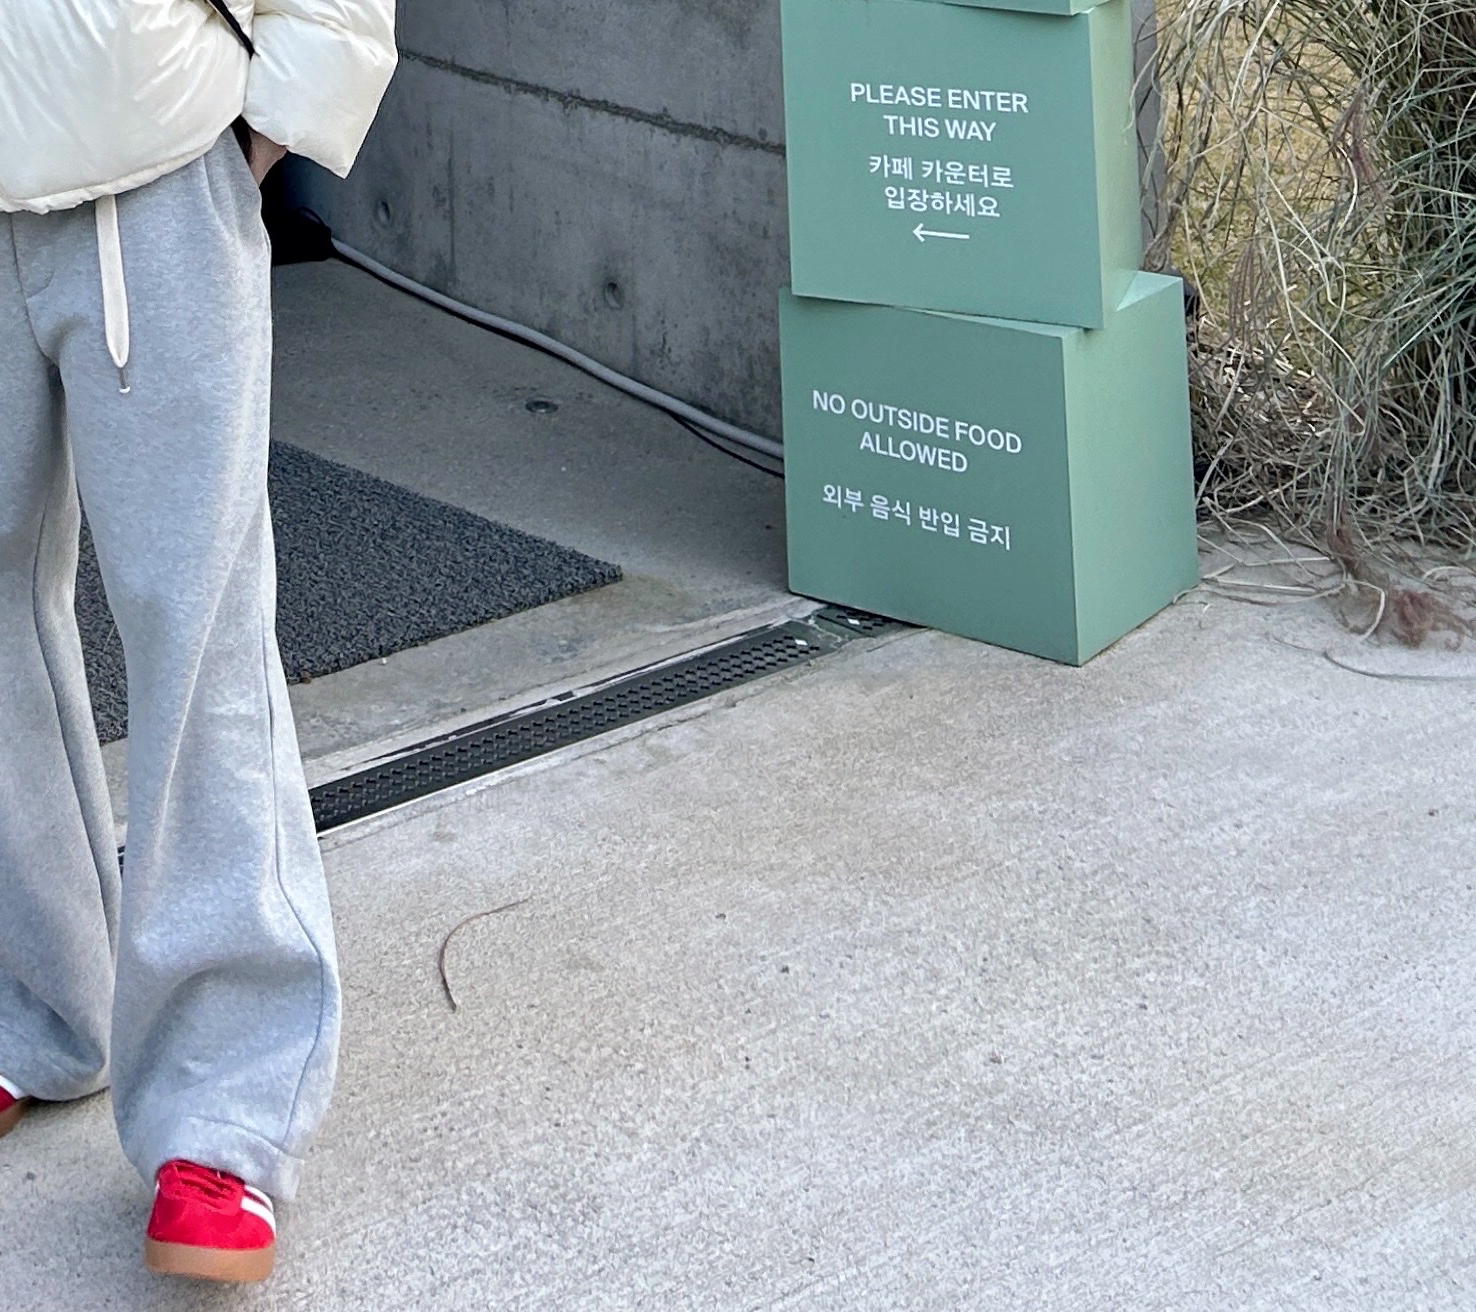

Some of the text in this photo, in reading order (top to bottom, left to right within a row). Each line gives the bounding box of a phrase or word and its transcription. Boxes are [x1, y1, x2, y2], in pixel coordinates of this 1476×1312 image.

[850, 82, 1029, 114] PLEASE ENTER
[883, 115, 997, 142] THIS WAY
[868, 154, 1014, 189] 카페 카운터로
[884, 186, 1001, 218] 입장하세요
[812, 389, 1023, 455] NO OUTSIDE FOOD
[859, 431, 969, 474] ALLOWED
[822, 483, 1012, 551] 외부 음식 반입 금지
